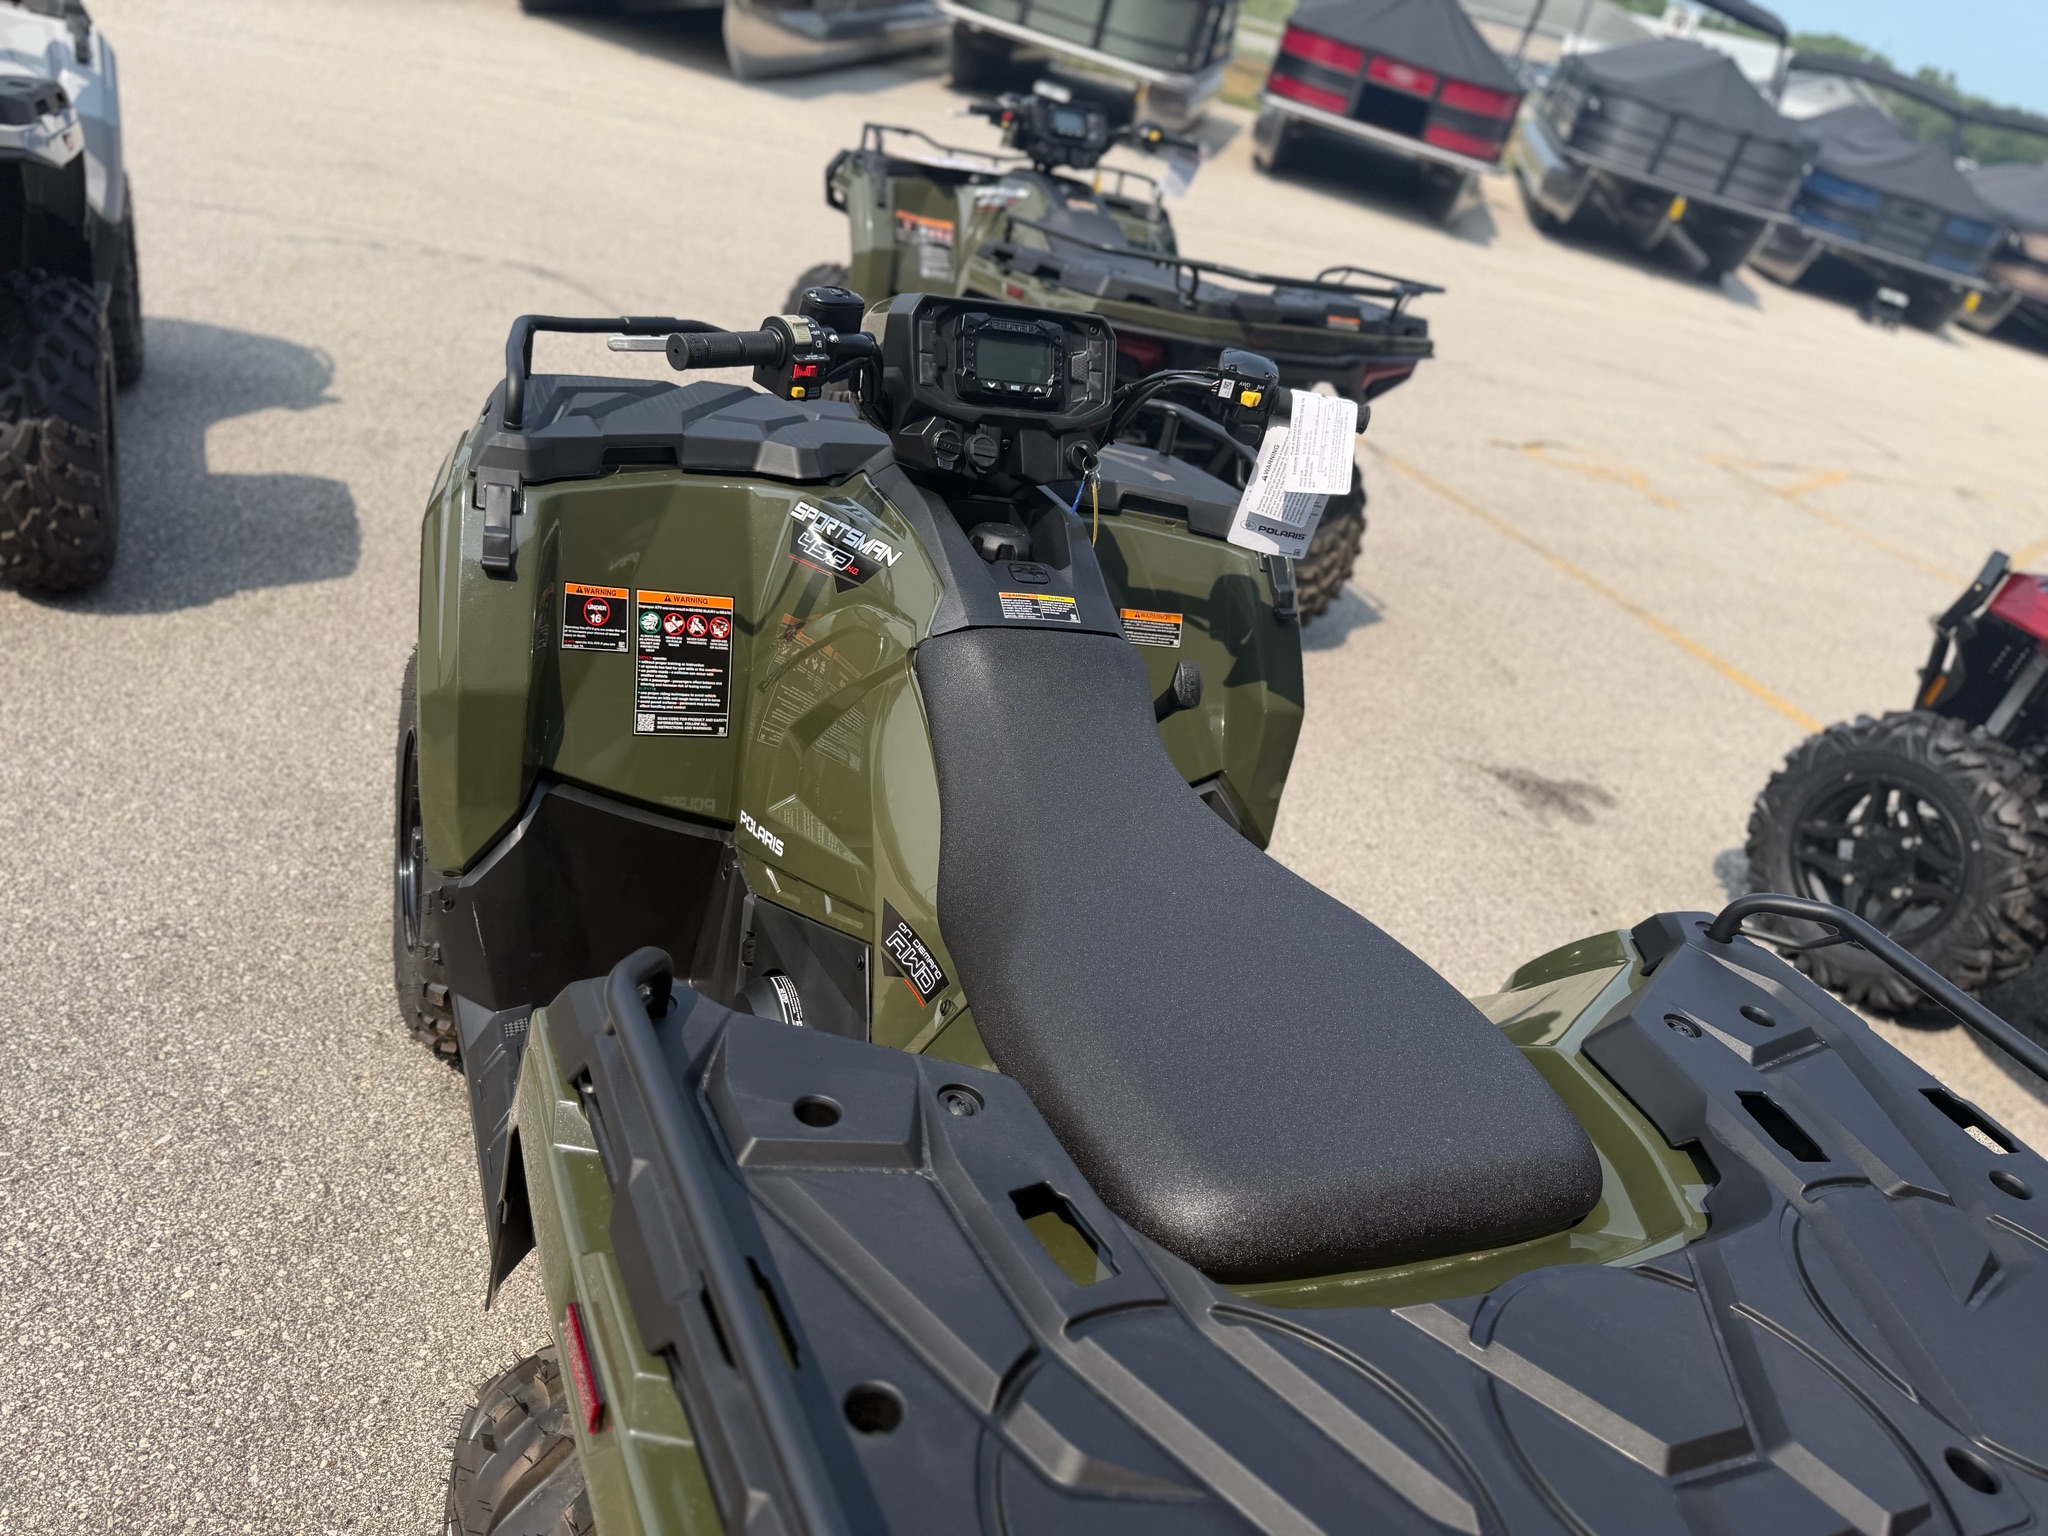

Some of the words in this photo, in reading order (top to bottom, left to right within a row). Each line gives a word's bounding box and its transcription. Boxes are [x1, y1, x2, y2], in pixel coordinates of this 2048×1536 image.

[1263, 444, 1280, 476] WARNING
[790, 501, 904, 567] SPORTSMAN
[797, 531, 855, 571] 450
[1257, 525, 1307, 541] POLARIS
[584, 587, 616, 596] WARNING
[673, 595, 708, 604] WARNING
[590, 614, 602, 623] 16
[740, 810, 785, 857] POLARIS
[886, 930, 936, 994] AWD
[912, 939, 942, 980] DEMAND
